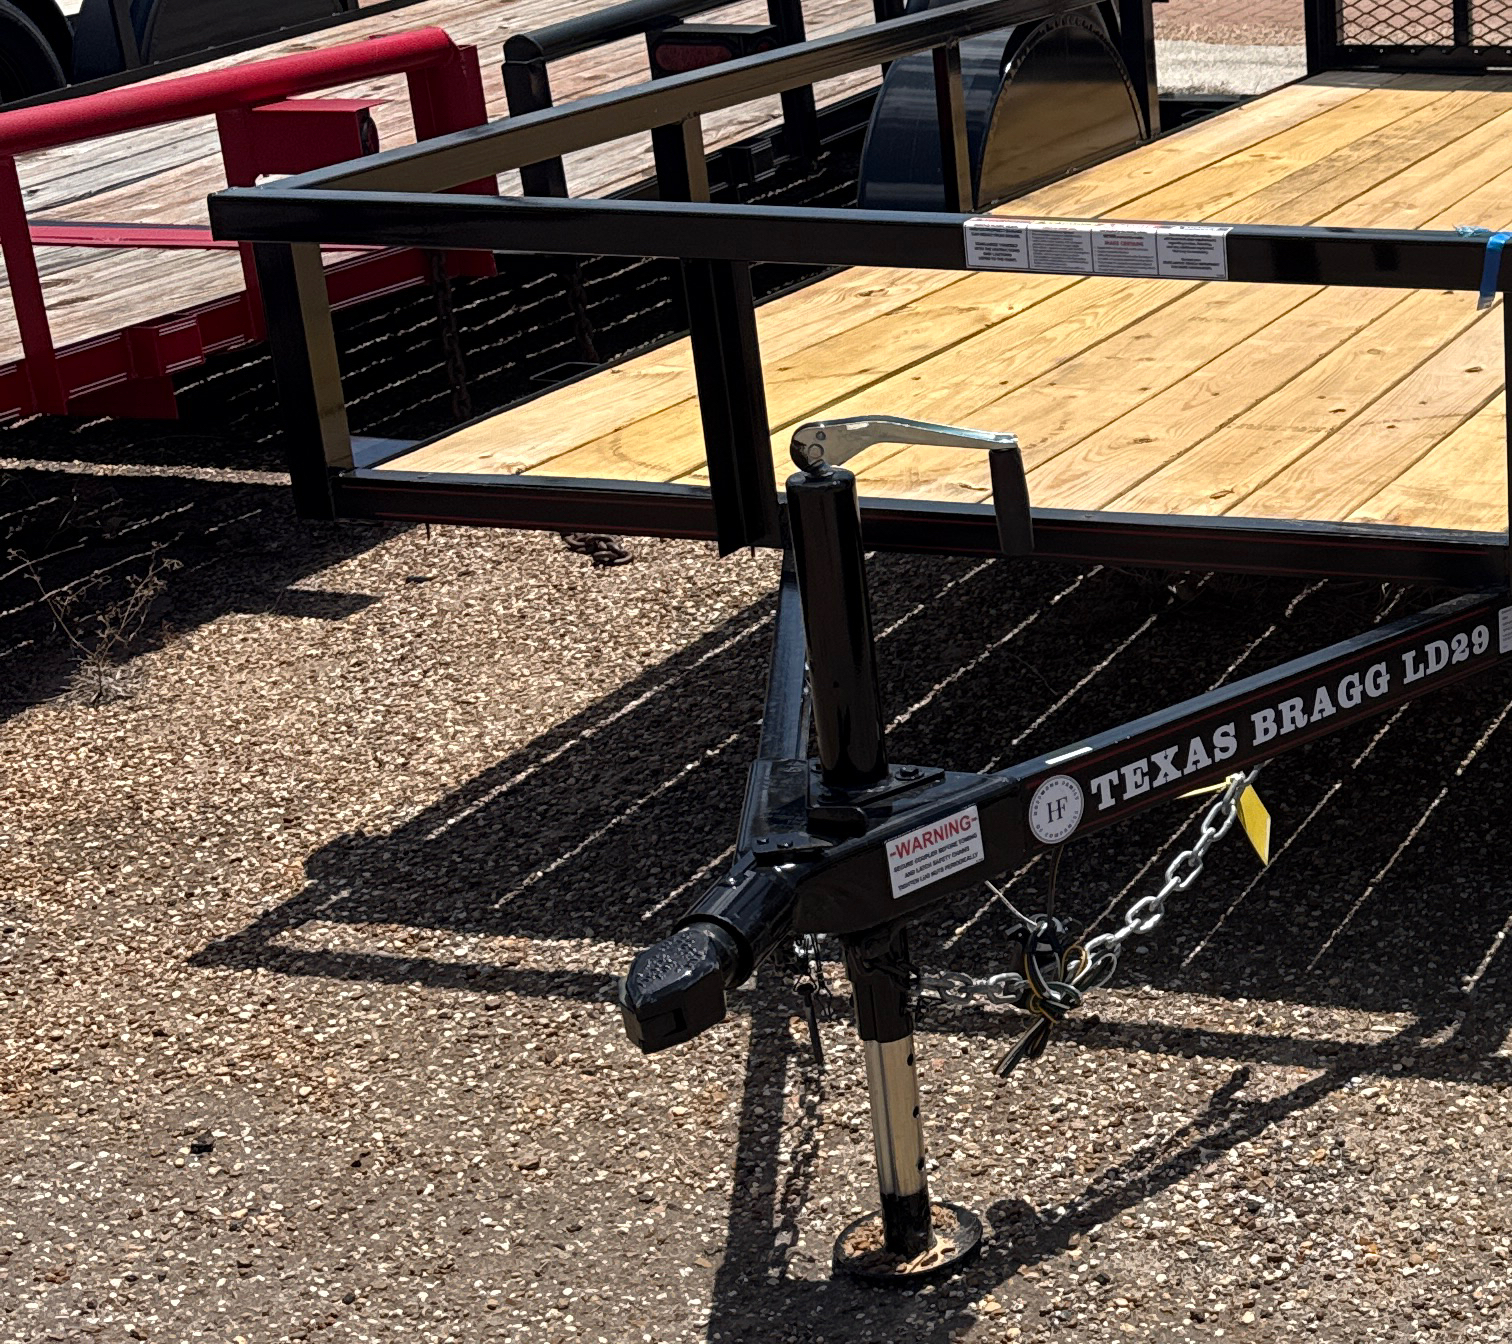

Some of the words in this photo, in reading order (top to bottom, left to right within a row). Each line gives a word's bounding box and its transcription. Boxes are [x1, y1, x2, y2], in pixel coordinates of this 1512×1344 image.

[1090, 721, 1238, 811] TEXAS
[1250, 662, 1390, 747] BRAGG
[1401, 625, 1490, 684] LD29
[1046, 796, 1068, 824] HF
